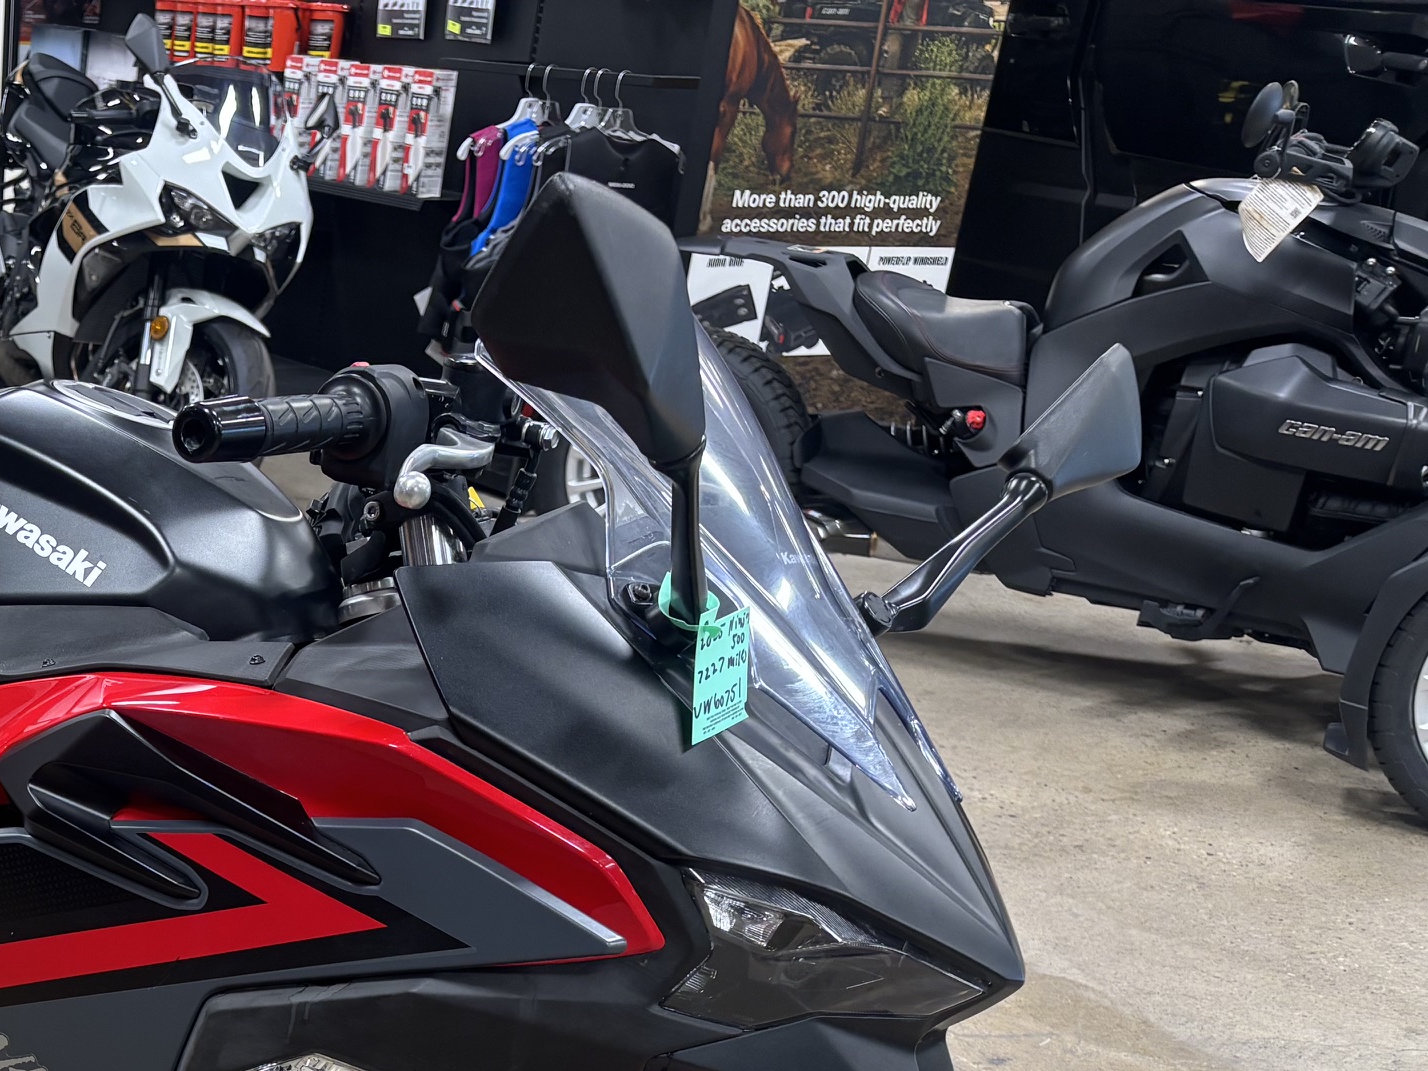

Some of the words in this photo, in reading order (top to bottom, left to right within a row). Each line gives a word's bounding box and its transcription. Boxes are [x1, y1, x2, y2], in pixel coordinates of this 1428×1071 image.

[731, 189, 776, 208] More
[779, 190, 815, 208] than
[817, 190, 848, 208] 300
[850, 190, 942, 213] high-quality
[721, 214, 817, 233] accessories
[819, 214, 851, 232] that
[853, 214, 870, 232] fit
[871, 214, 942, 237] perfectly
[1278, 419, 1390, 451] can-am
[697, 656, 725, 684] 7227
